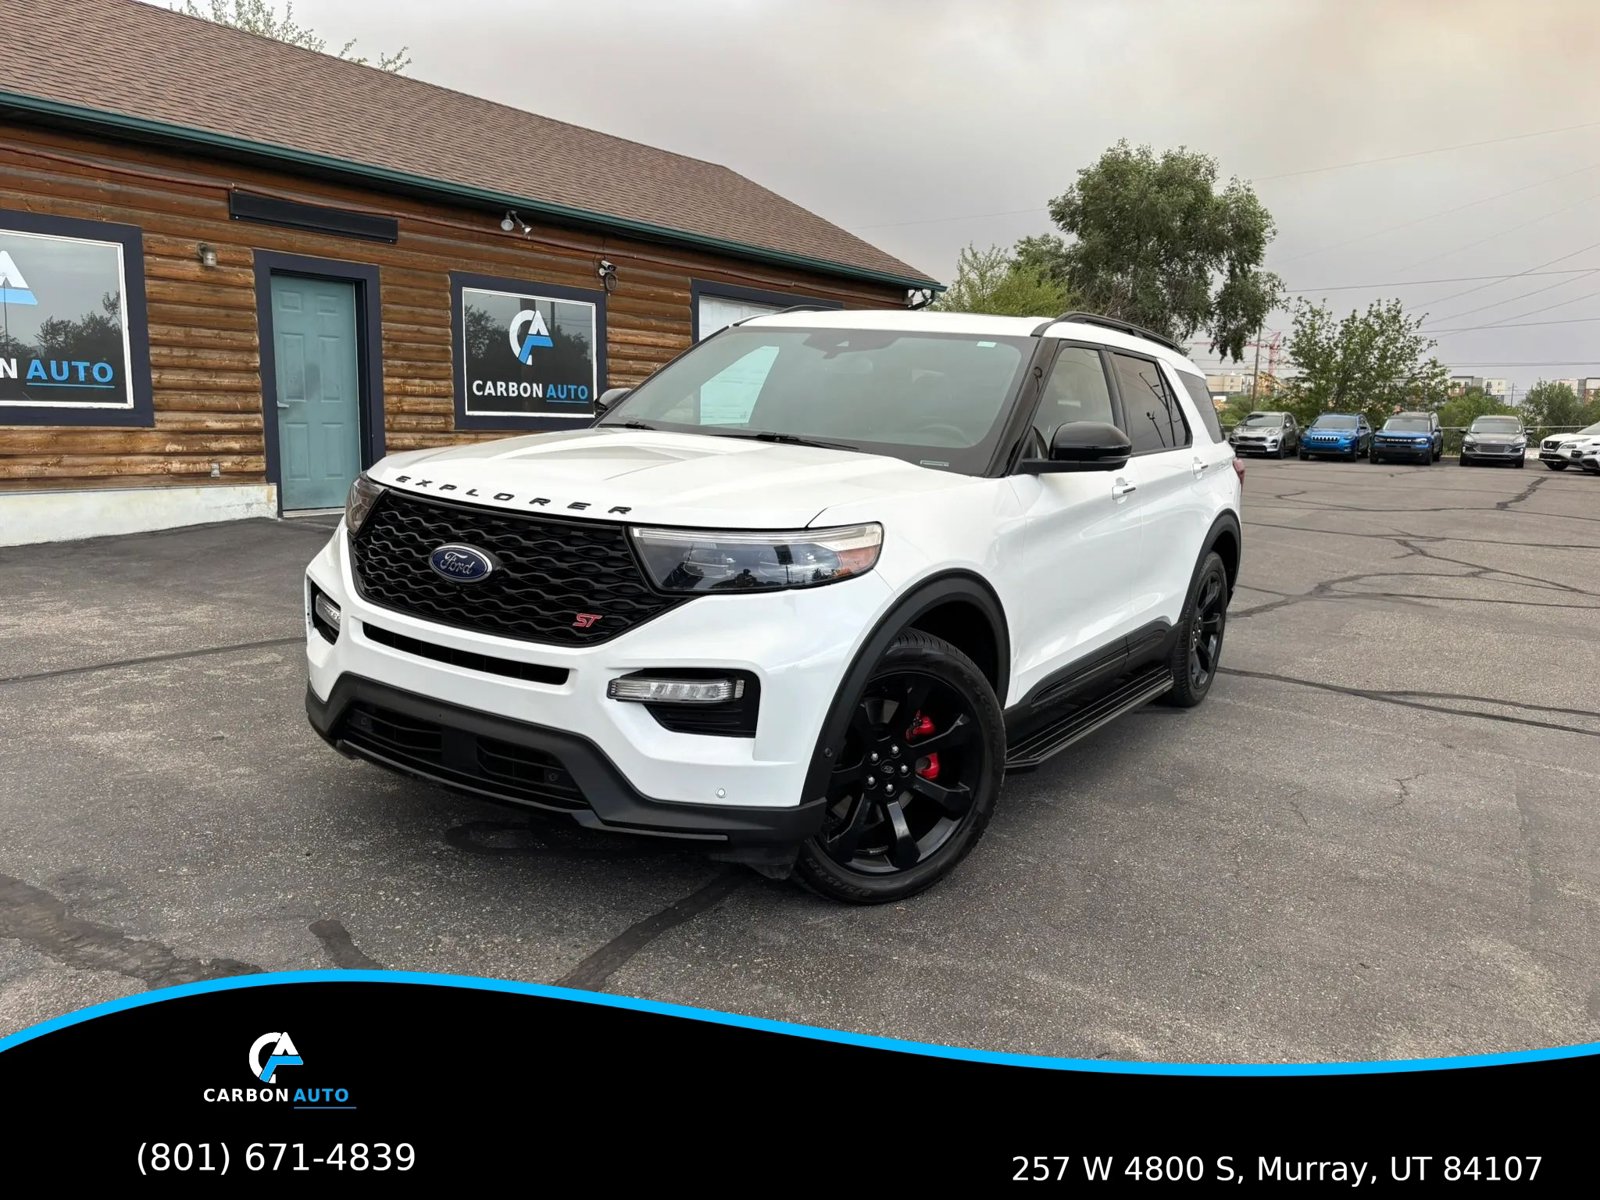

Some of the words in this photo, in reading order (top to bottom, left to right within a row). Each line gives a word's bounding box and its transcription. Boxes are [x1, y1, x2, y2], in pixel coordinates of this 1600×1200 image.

[26, 358, 114, 384] AUTO
[472, 380, 543, 398] CARBON
[546, 383, 589, 400] AUTO
[395, 475, 633, 515] EXPLORER
[440, 551, 476, 575] Ford
[572, 612, 603, 628] ST
